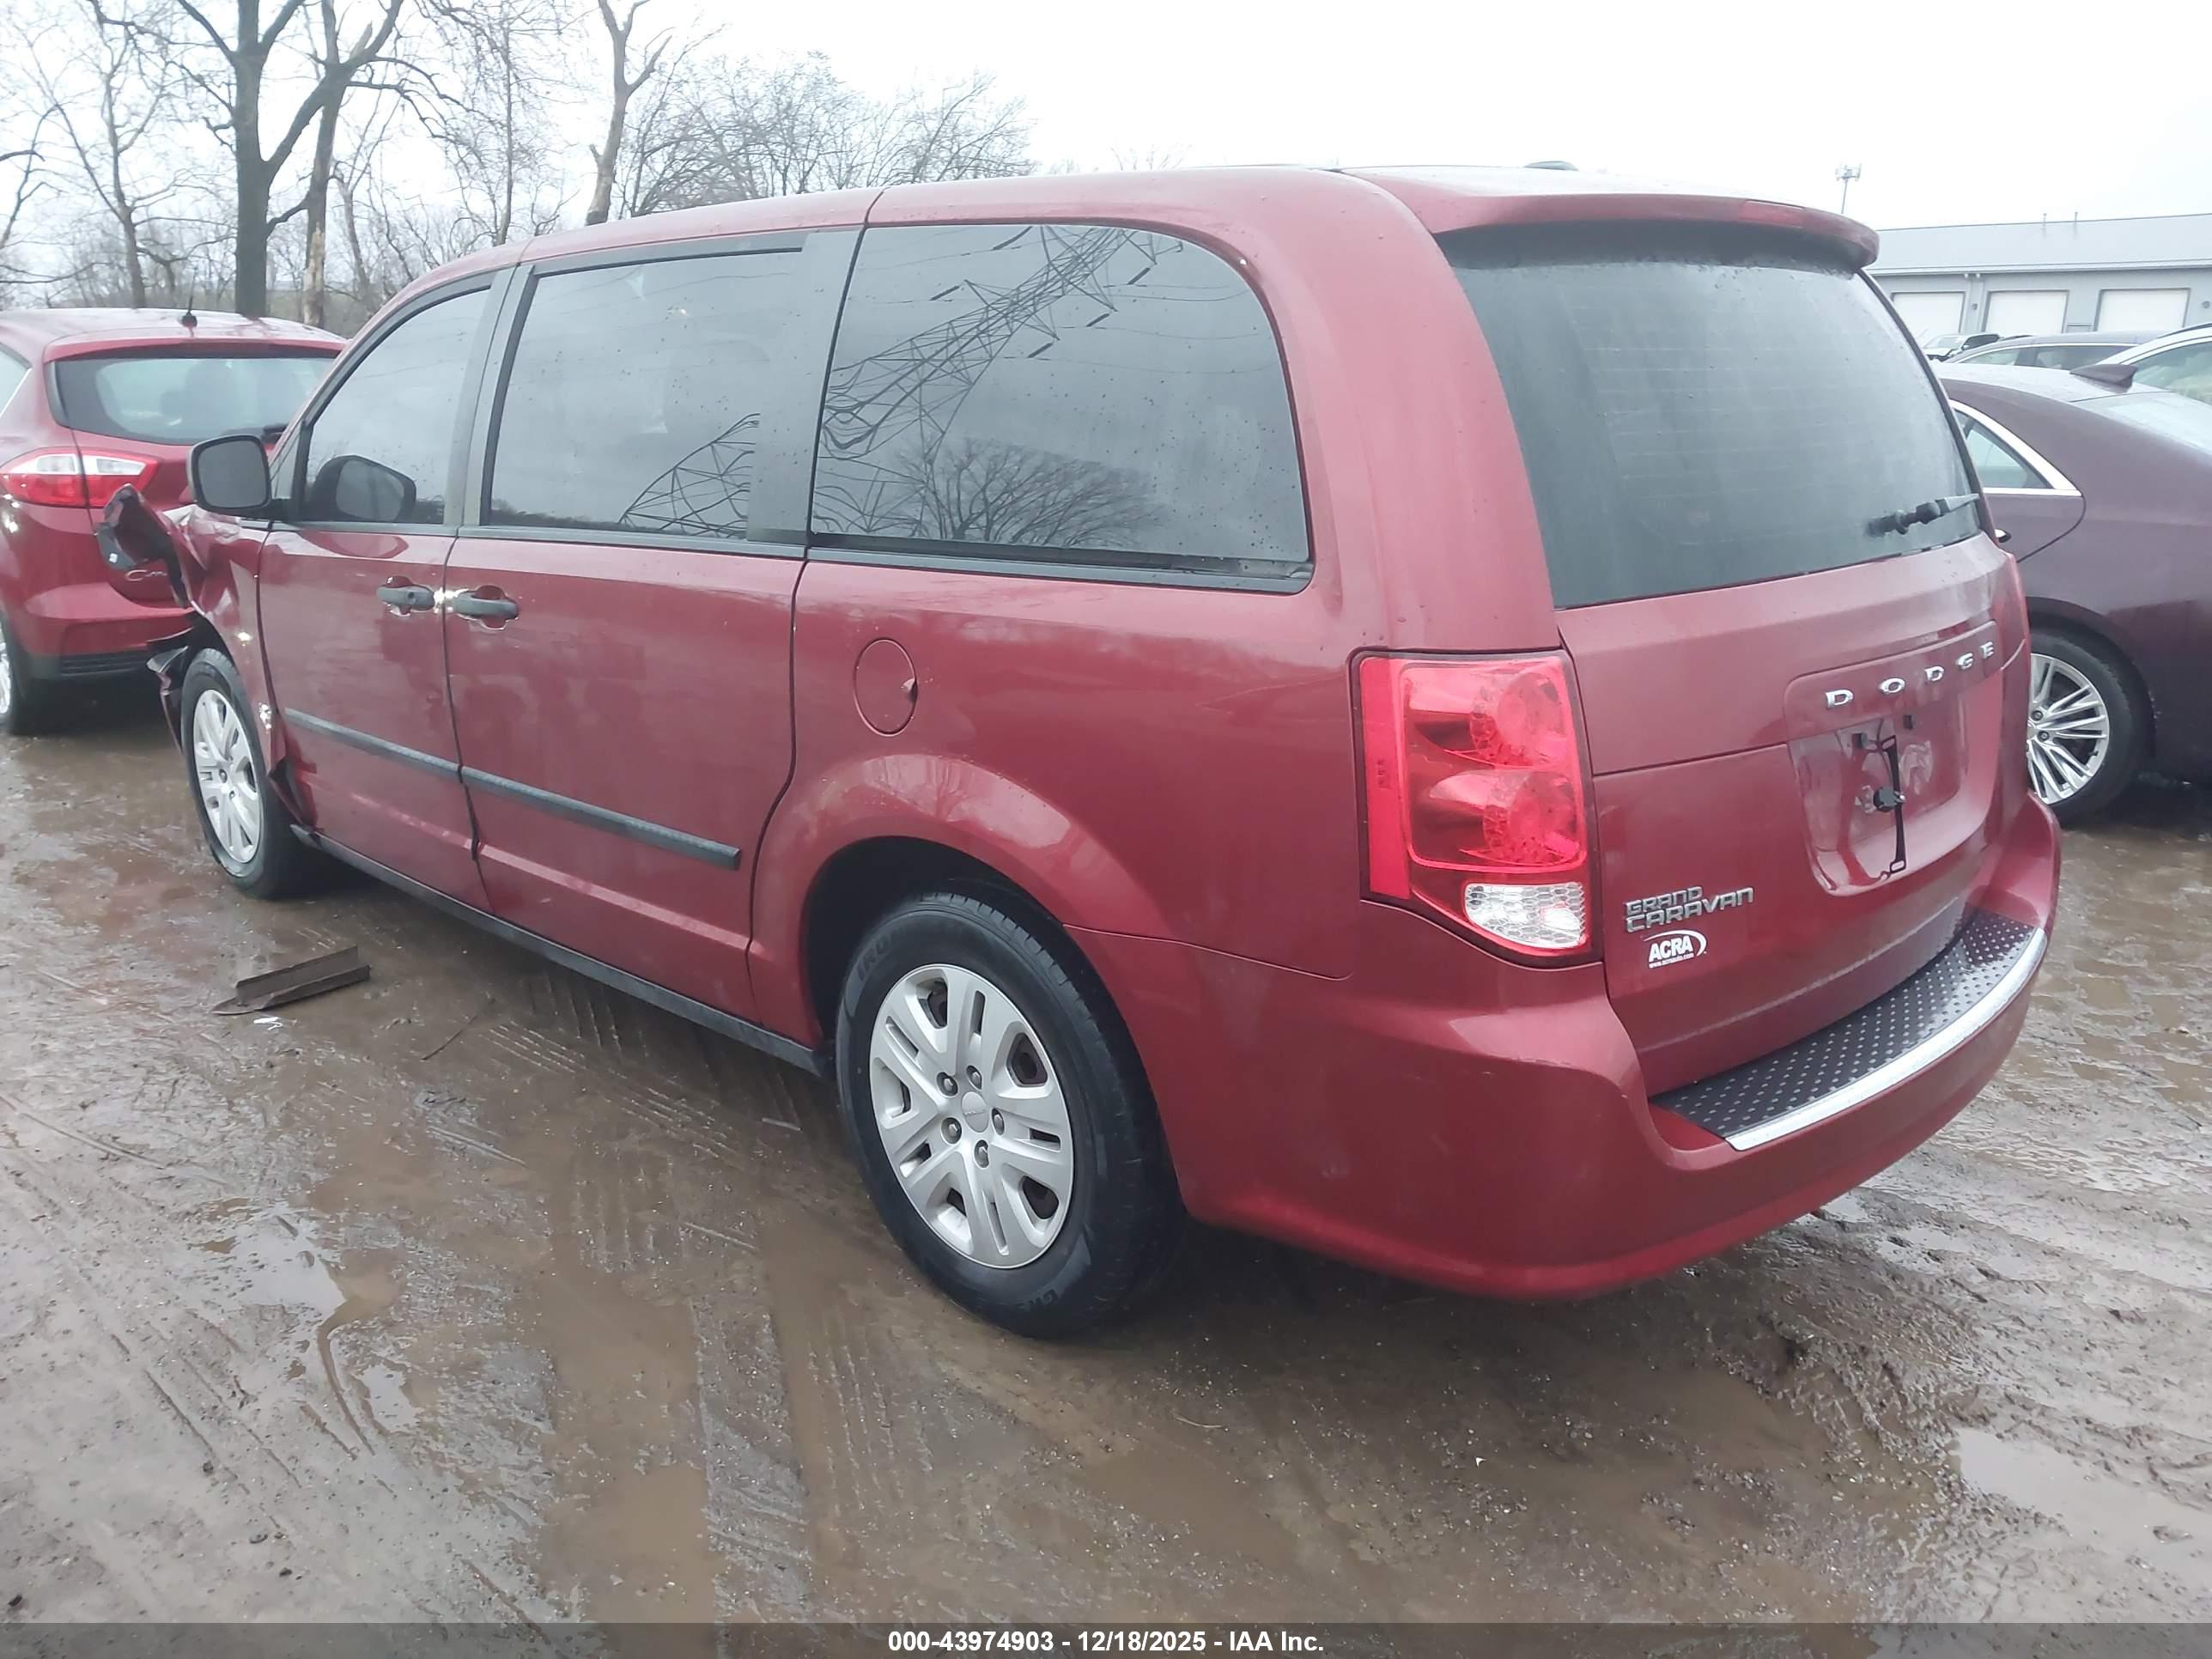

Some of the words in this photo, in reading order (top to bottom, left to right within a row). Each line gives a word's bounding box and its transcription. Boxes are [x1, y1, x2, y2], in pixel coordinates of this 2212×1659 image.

[1825, 641, 1995, 708] DODGE
[1625, 886, 1704, 915] GRAND
[1625, 887, 1755, 933] CARAVAN
[1648, 935, 1694, 963] ACRA
